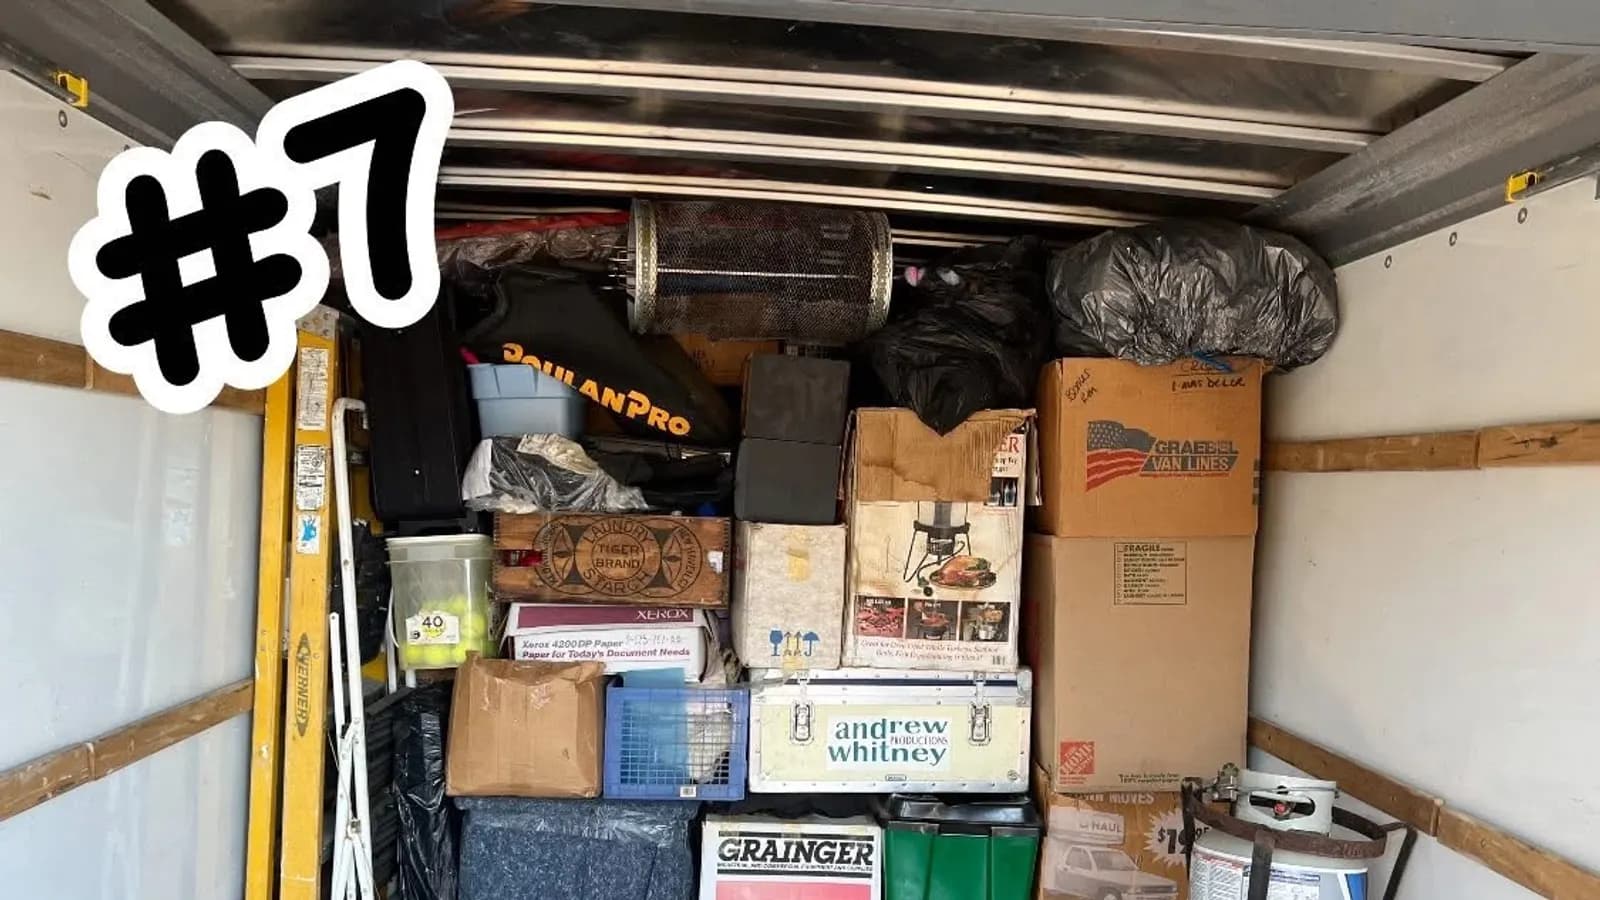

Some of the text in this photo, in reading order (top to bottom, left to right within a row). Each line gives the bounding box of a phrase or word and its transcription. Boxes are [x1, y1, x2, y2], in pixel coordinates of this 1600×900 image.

[1155, 439, 1240, 454] GRAEBEL
[1152, 456, 1229, 471] VAN LINES
[582, 518, 655, 544] LAUNDRY
[596, 543, 641, 556] TIGER
[1123, 544, 1161, 553] FRAGILE
[595, 558, 641, 569] BRAND
[582, 569, 654, 594] STARCH
[635, 608, 689, 621] XEROX
[422, 615, 444, 629] 40
[522, 640, 549, 649] Xerox
[594, 640, 624, 650] Paper
[522, 648, 691, 660] Paper for Today's Document Needs
[295, 647, 312, 724] WERNER
[835, 718, 949, 740] andrew
[890, 735, 949, 745] PRODUCTIONS
[828, 741, 947, 767] whitney
[1060, 743, 1093, 774] HOME
[1109, 791, 1155, 805] MOVES
[718, 838, 875, 866] GRAINGER
